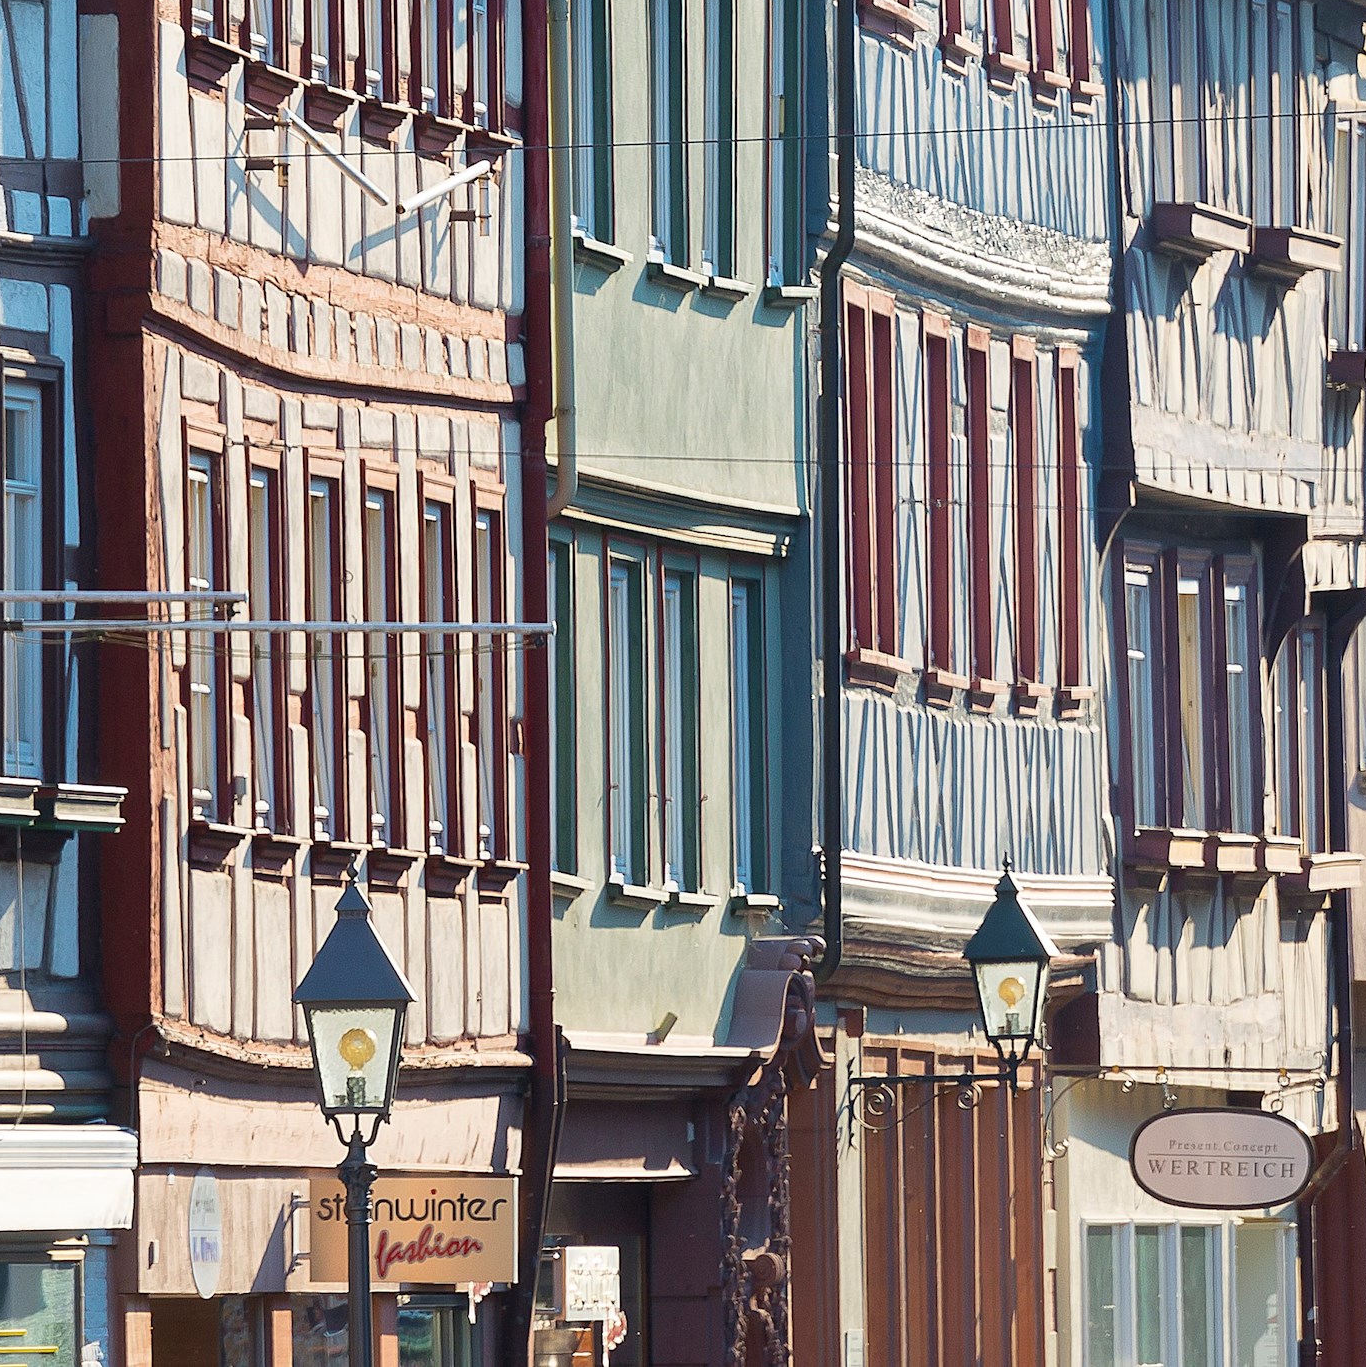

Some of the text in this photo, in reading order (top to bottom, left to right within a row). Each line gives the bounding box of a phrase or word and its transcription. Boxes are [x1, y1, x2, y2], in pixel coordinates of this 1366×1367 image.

[1223, 1140, 1278, 1155] Concept
[1147, 1159, 1296, 1179] WERTREICH
[316, 1188, 508, 1222] stnwinter
[374, 1223, 483, 1279] fashion
